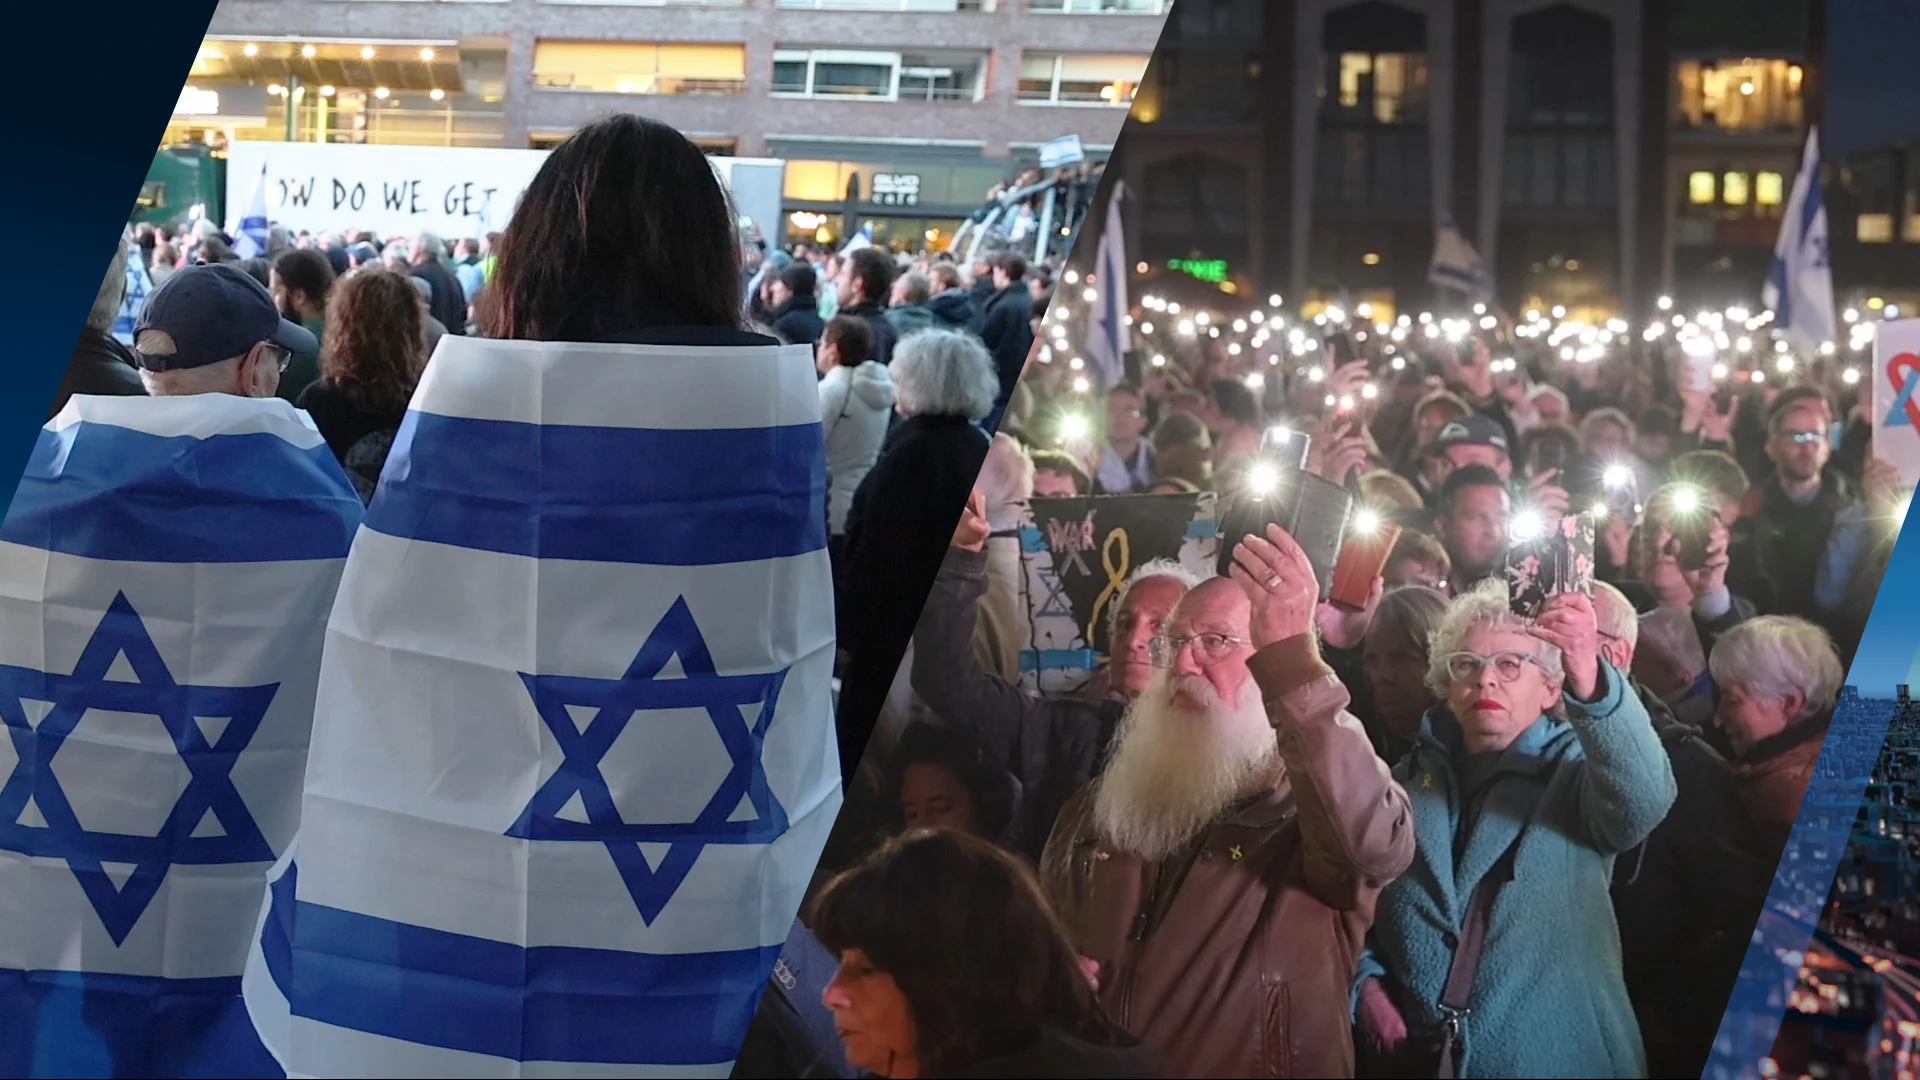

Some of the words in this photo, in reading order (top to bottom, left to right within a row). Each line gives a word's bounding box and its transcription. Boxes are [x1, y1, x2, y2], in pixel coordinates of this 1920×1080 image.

[332, 178, 366, 211] DO
[383, 180, 427, 214] WE
[444, 182, 498, 216] GET
